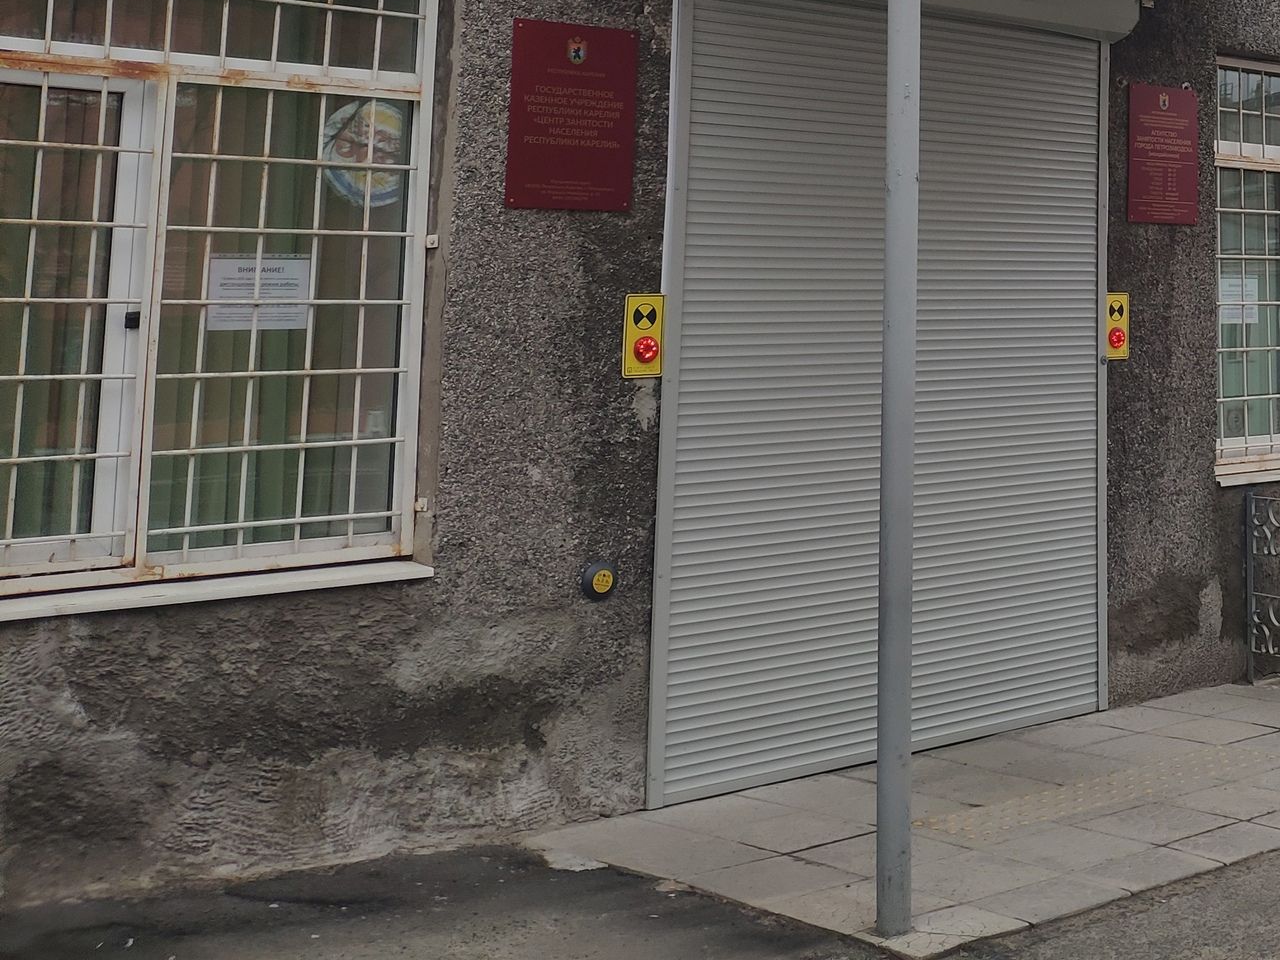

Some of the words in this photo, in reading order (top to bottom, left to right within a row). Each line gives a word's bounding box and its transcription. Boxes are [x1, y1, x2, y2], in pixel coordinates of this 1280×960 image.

[535, 85, 615, 99] ГОСУДАРСТВЕННОЕ
[524, 95, 569, 105] КАЗЕННОЕ
[570, 98, 624, 110] УЧРЕЖДЕНИЕ
[527, 104, 582, 116] РЕСПУБЛИКИ
[583, 109, 621, 119] КАРЕЛИЯ
[566, 118, 614, 128] ЗАНЯТОСТИ
[548, 127, 599, 137] НАСЕЛЕНИЯ
[523, 135, 581, 145] РЕСПУБЛИКИ
[237, 266, 285, 274] ВНИАНИЕ!
